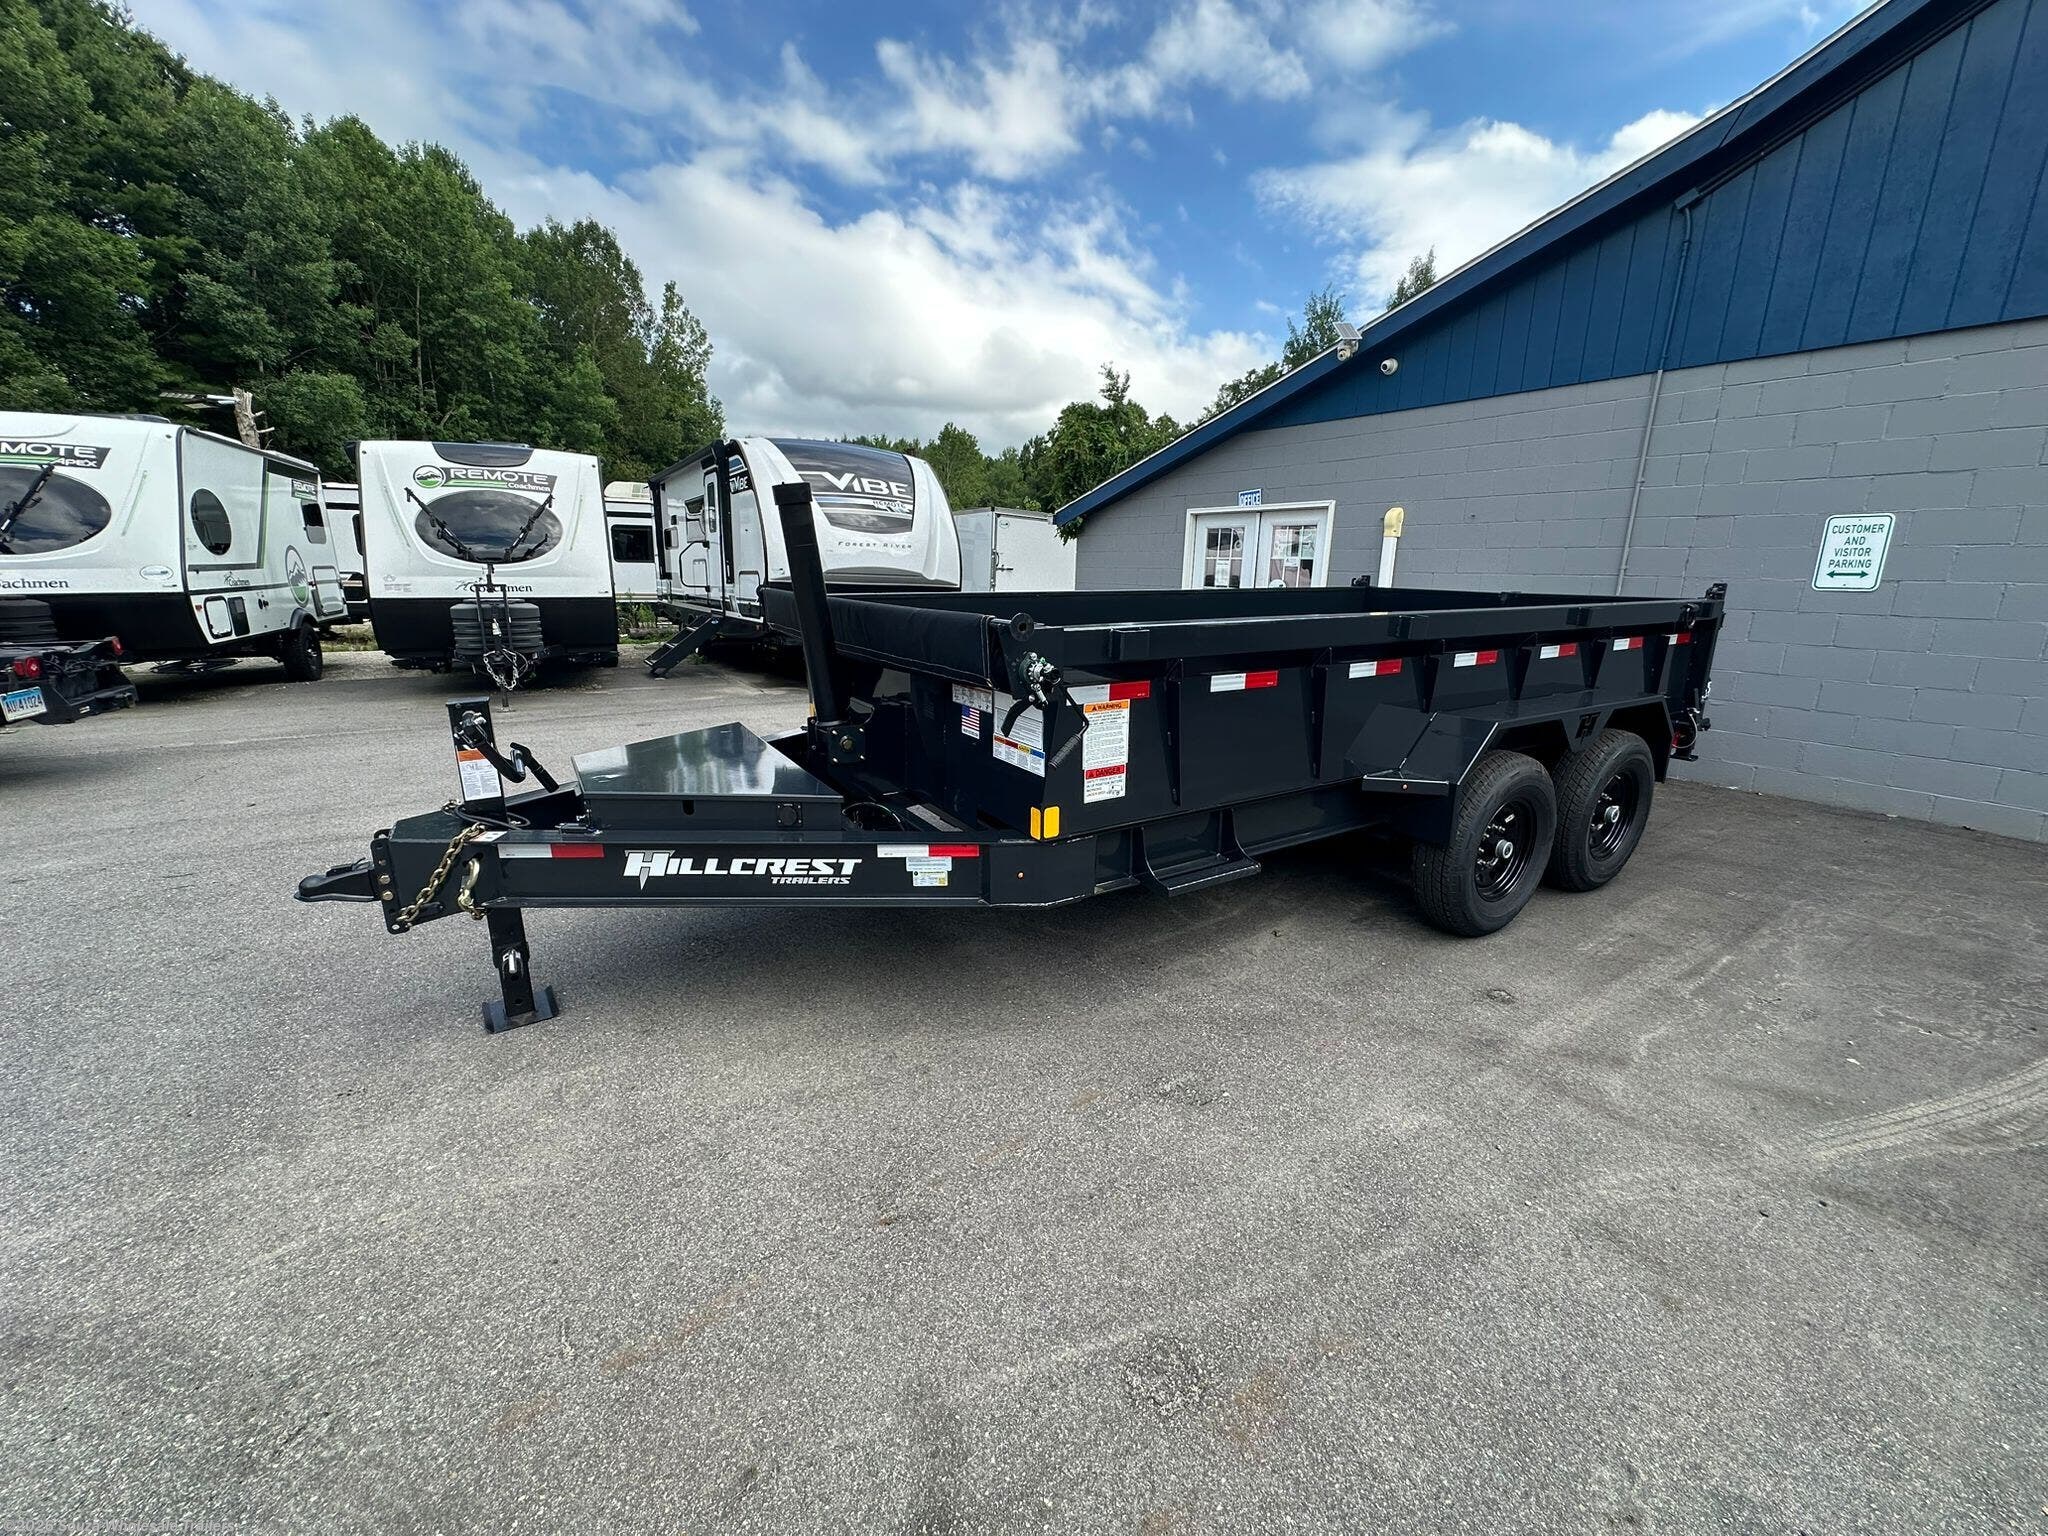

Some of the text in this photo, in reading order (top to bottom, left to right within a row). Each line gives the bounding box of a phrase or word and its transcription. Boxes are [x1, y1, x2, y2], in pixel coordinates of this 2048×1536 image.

[52, 457, 97, 468] APEX
[449, 468, 549, 485] REMOTE
[507, 482, 551, 492] Coachmen
[731, 476, 748, 492] VIBE
[822, 472, 912, 499] VIBE
[1240, 493, 1260, 506] OFFICE
[1832, 524, 1885, 534] CUSTOMER
[1844, 536, 1866, 545] AND
[1834, 548, 1872, 557] VISITOR
[1828, 559, 1872, 568] PARKING
[0, 578, 70, 589] achmen
[623, 850, 863, 882] HILLCREST
[770, 876, 851, 885] TRAILERS
